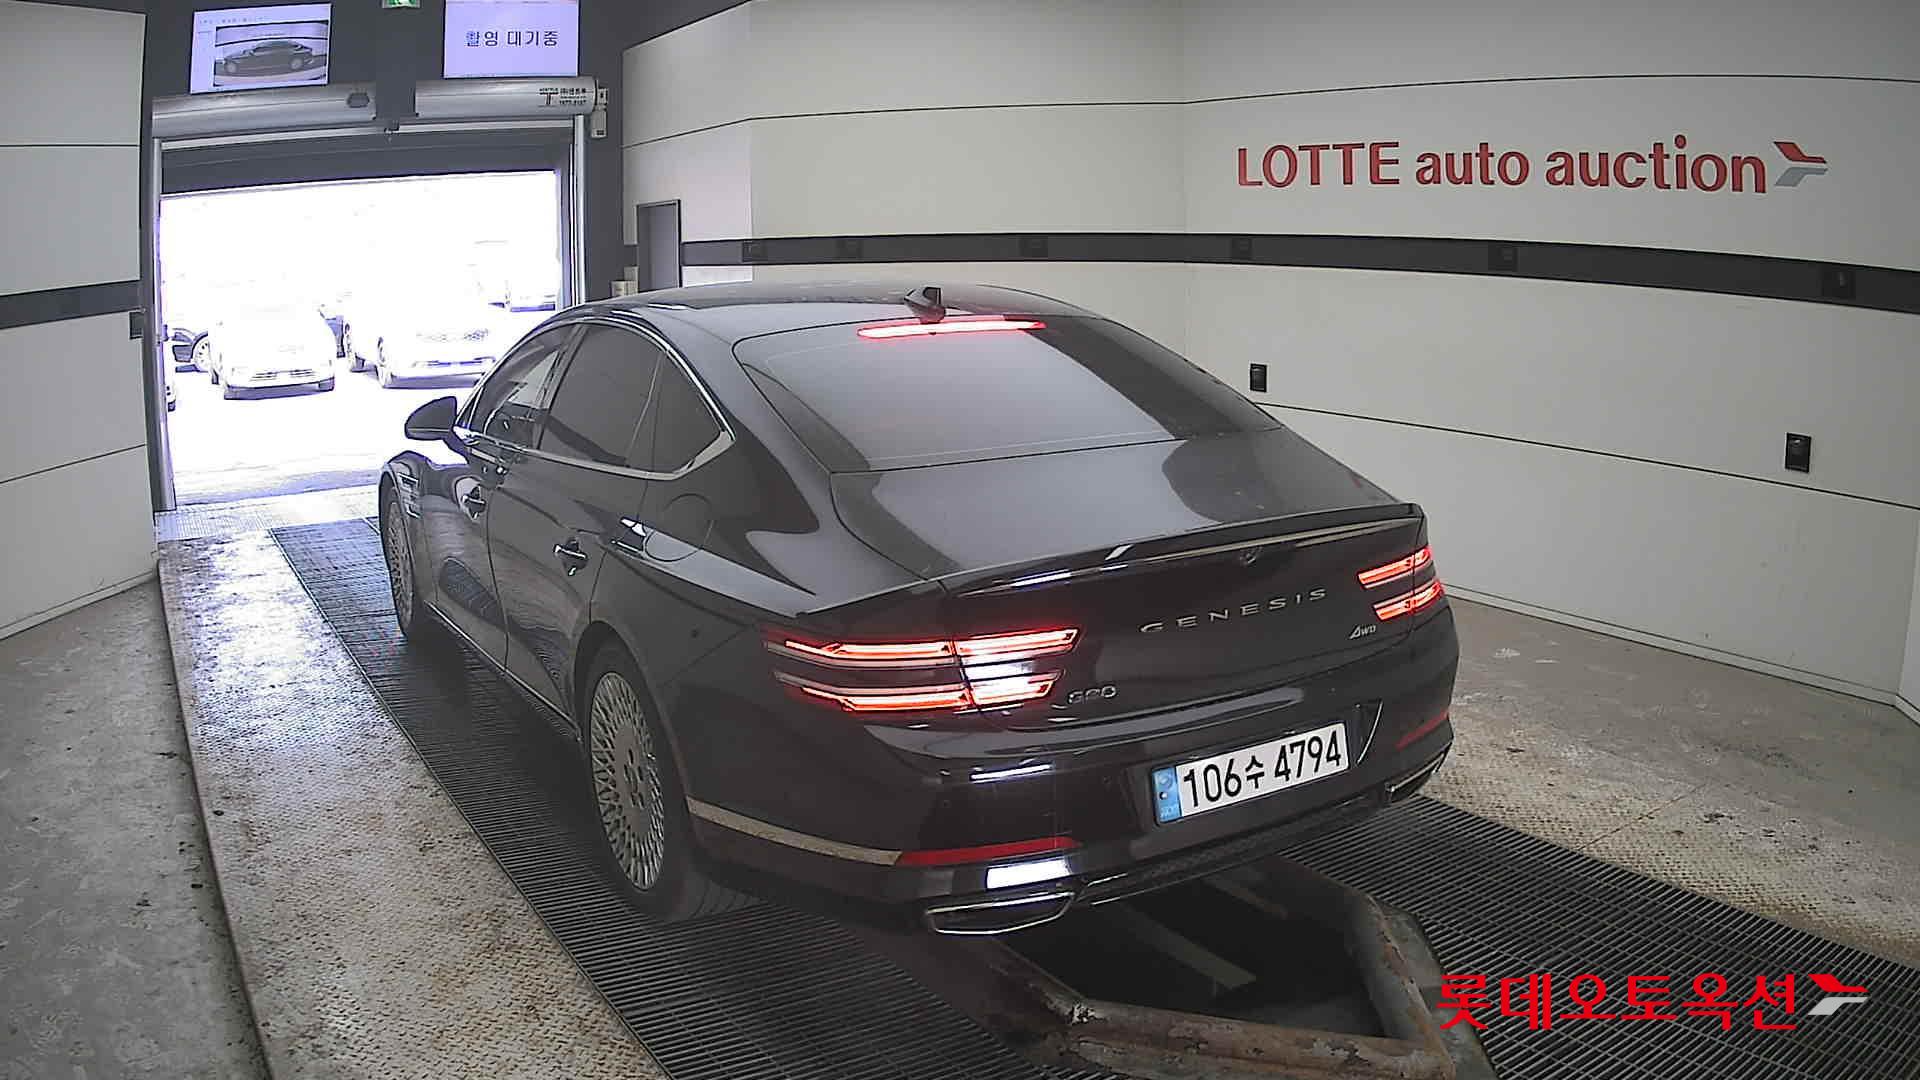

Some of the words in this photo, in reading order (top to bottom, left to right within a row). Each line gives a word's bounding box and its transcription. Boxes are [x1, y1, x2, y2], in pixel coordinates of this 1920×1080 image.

[507, 31, 559, 47] 대기중
[1237, 141, 1400, 188] LOTTE
[1416, 143, 1530, 187] auto
[1544, 135, 1767, 194] auction
[1140, 588, 1327, 632] GENESIS
[1183, 755, 1266, 808] 106수
[1274, 730, 1342, 782] 4794
